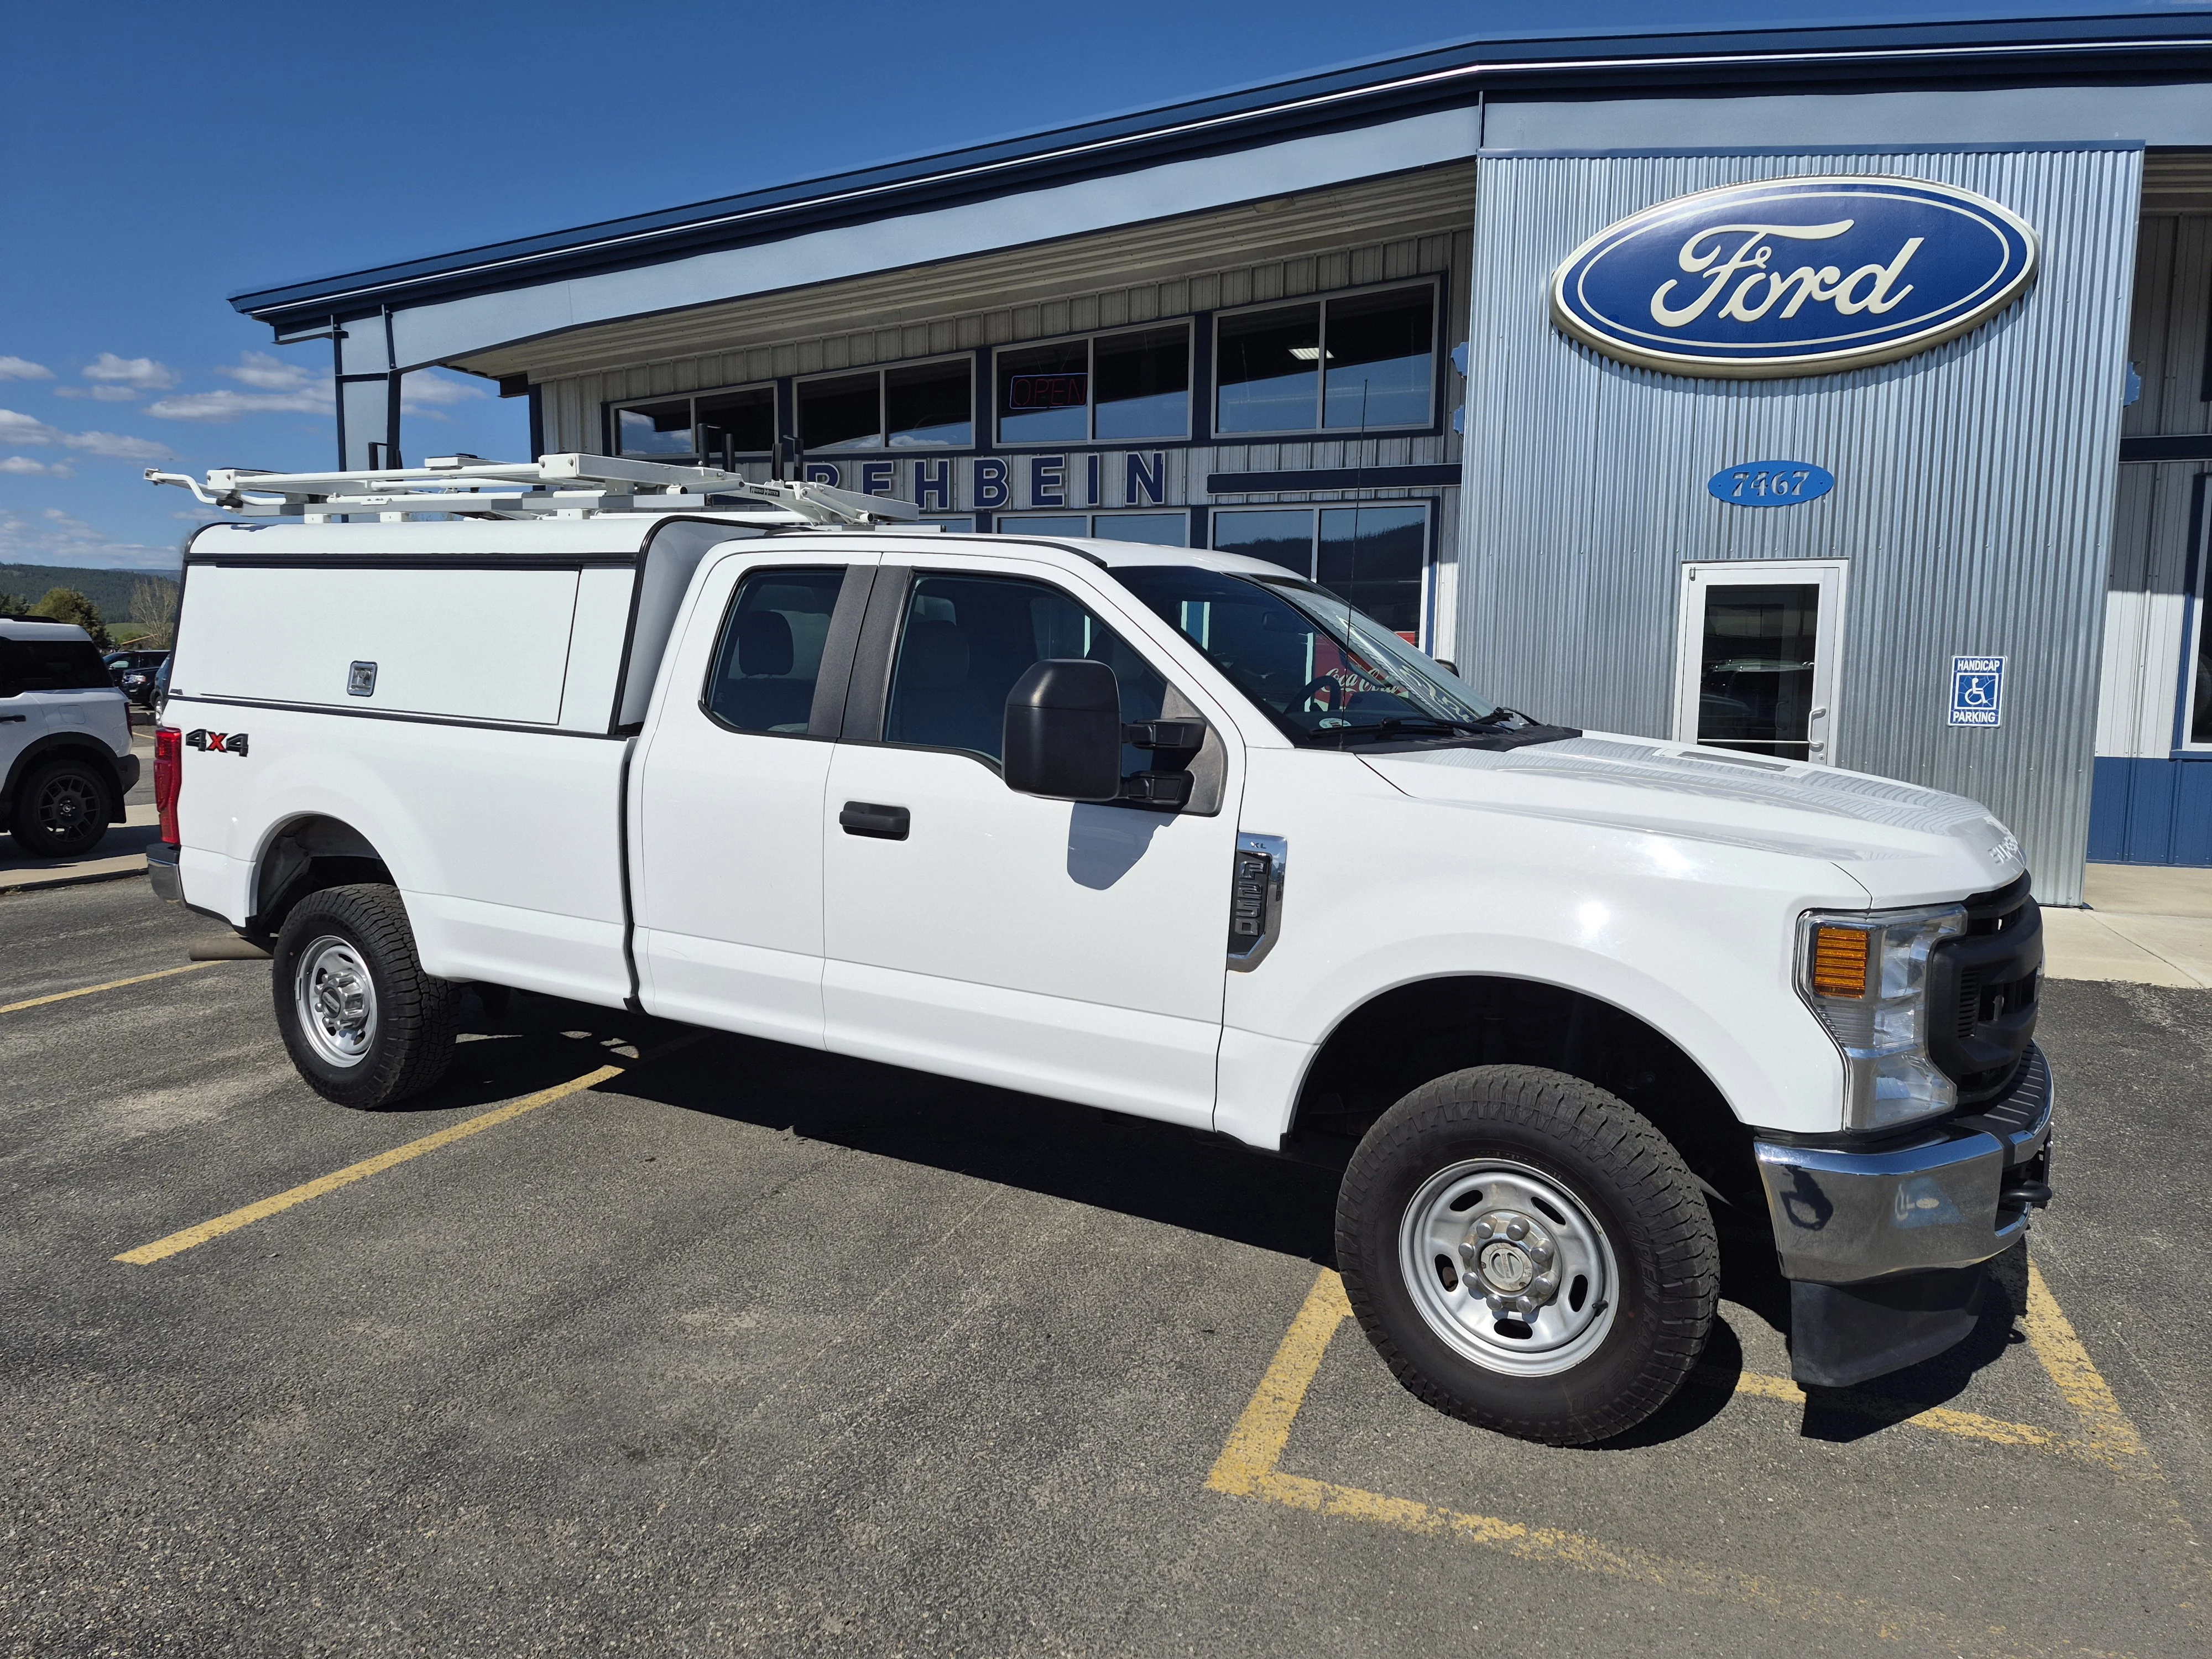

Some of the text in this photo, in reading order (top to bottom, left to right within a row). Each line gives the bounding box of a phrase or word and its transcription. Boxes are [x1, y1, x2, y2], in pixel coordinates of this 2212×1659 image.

[1651, 219, 1924, 327] Ford
[1013, 378, 1087, 405] OPEN
[1732, 470, 1809, 497] 7467
[1958, 660, 2000, 671] HANDICAP
[1953, 711, 1995, 722] PARKING
[1625, 1222, 1660, 1303] OPEN
